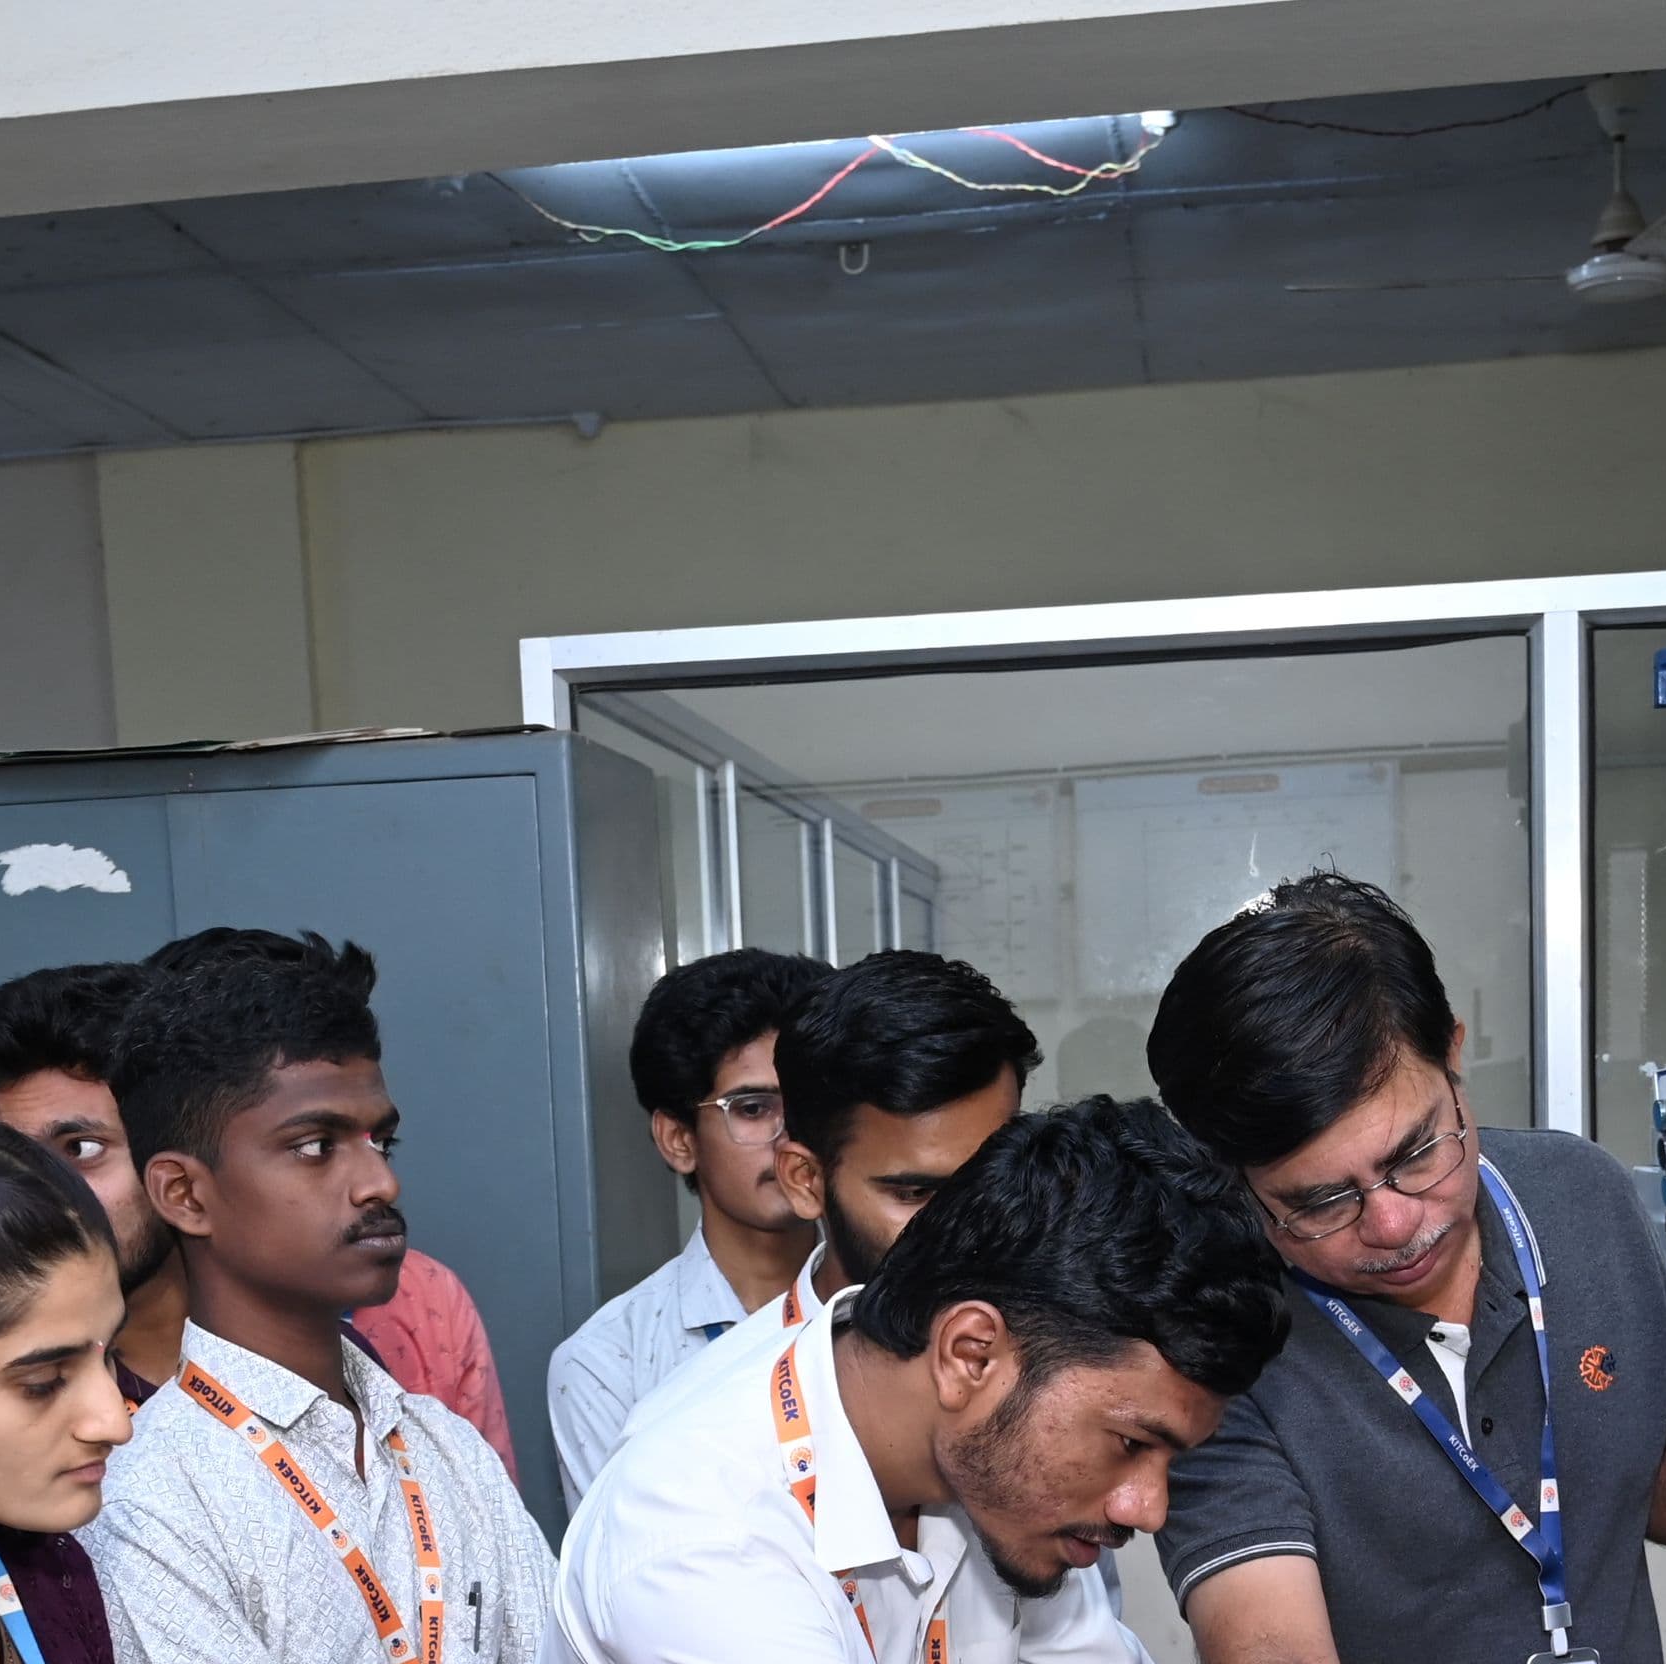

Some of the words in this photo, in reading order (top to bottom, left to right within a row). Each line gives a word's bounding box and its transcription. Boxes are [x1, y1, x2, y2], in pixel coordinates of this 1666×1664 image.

[1326, 1299, 1362, 1336] KITCoEK
[189, 1374, 235, 1417] KITCoEK
[1448, 1434, 1479, 1473] KITCoEK
[275, 1457, 321, 1514] KITCoEK
[410, 1494, 433, 1553] KITCoEK
[355, 1564, 391, 1623] KITCoEK
